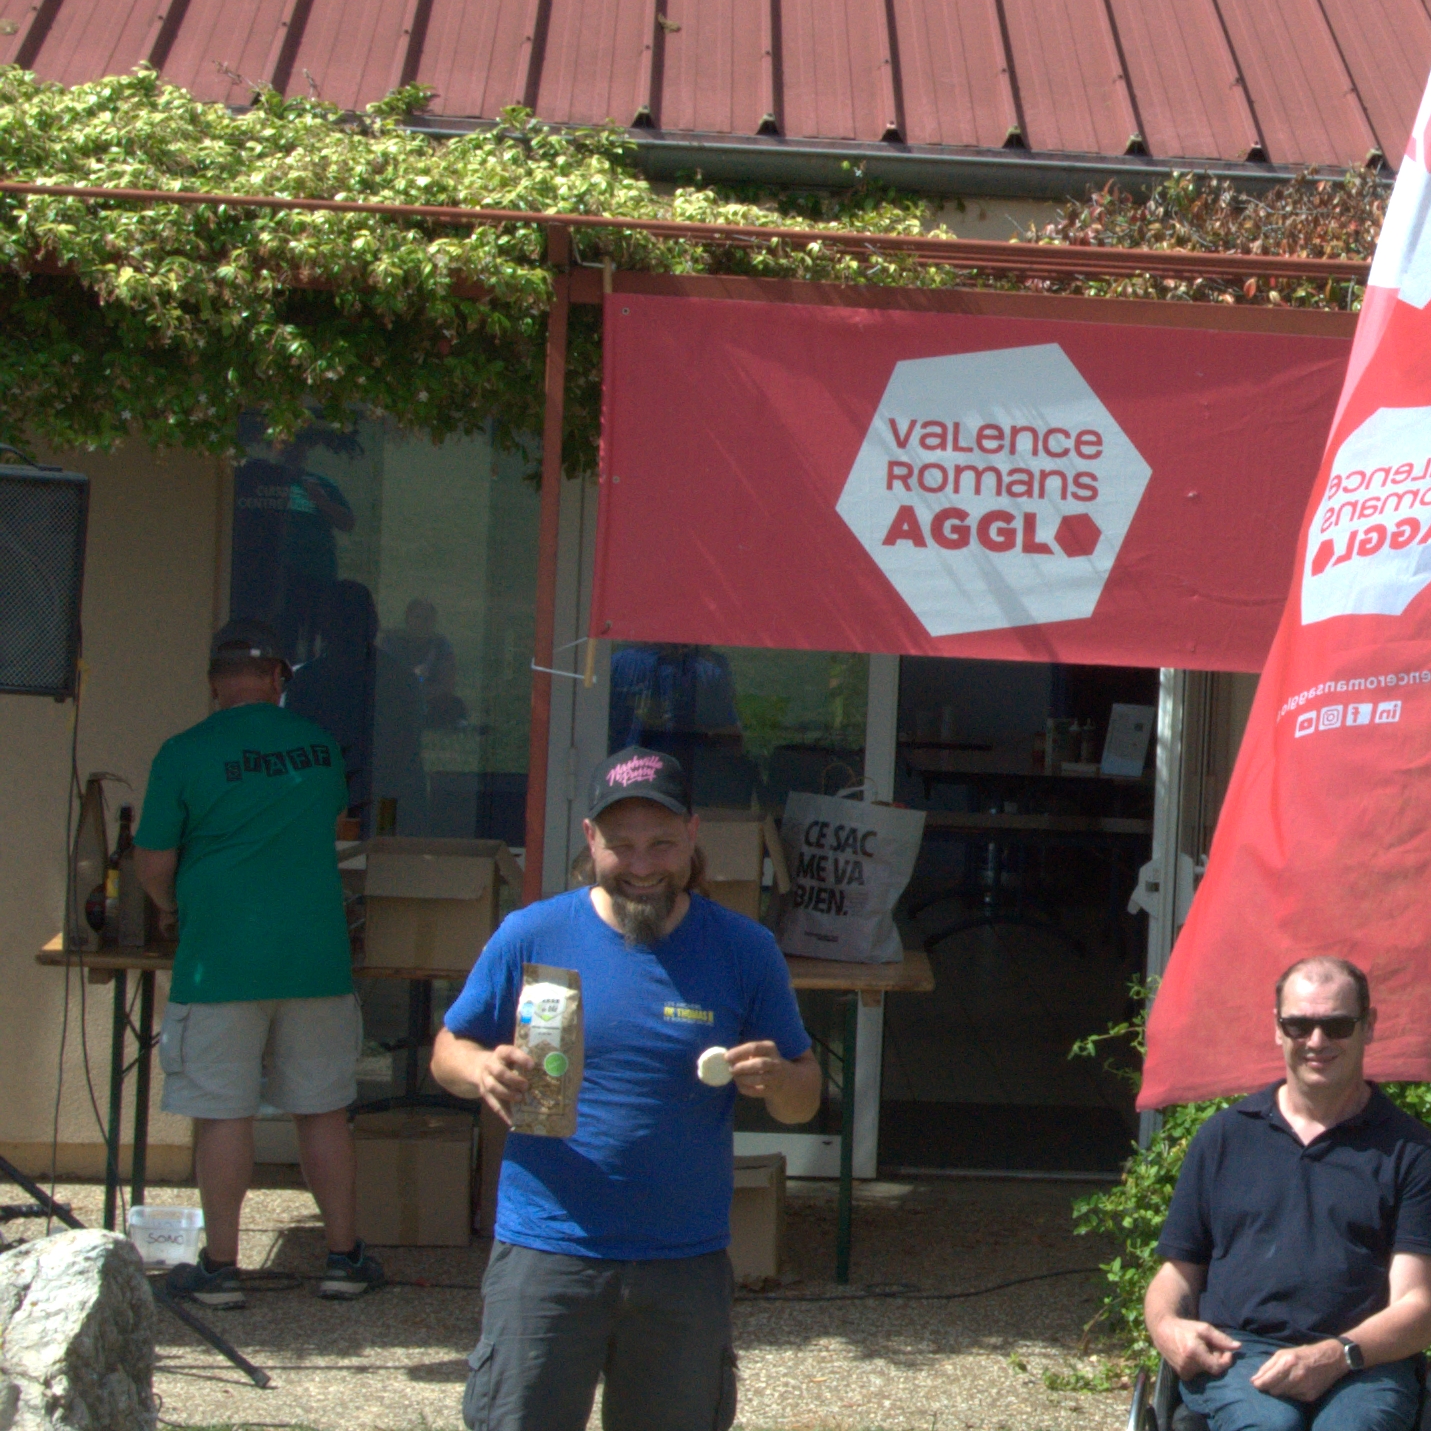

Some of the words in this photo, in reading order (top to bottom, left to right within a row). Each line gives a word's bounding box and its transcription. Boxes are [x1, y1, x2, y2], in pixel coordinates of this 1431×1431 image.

[886, 460, 1098, 502] Romans
[224, 744, 331, 782] STAFF
[804, 820, 831, 849] CE
[830, 824, 877, 858] SAC
[796, 851, 829, 882] ME
[834, 857, 865, 885] VA
[793, 883, 848, 916] BIEN.
